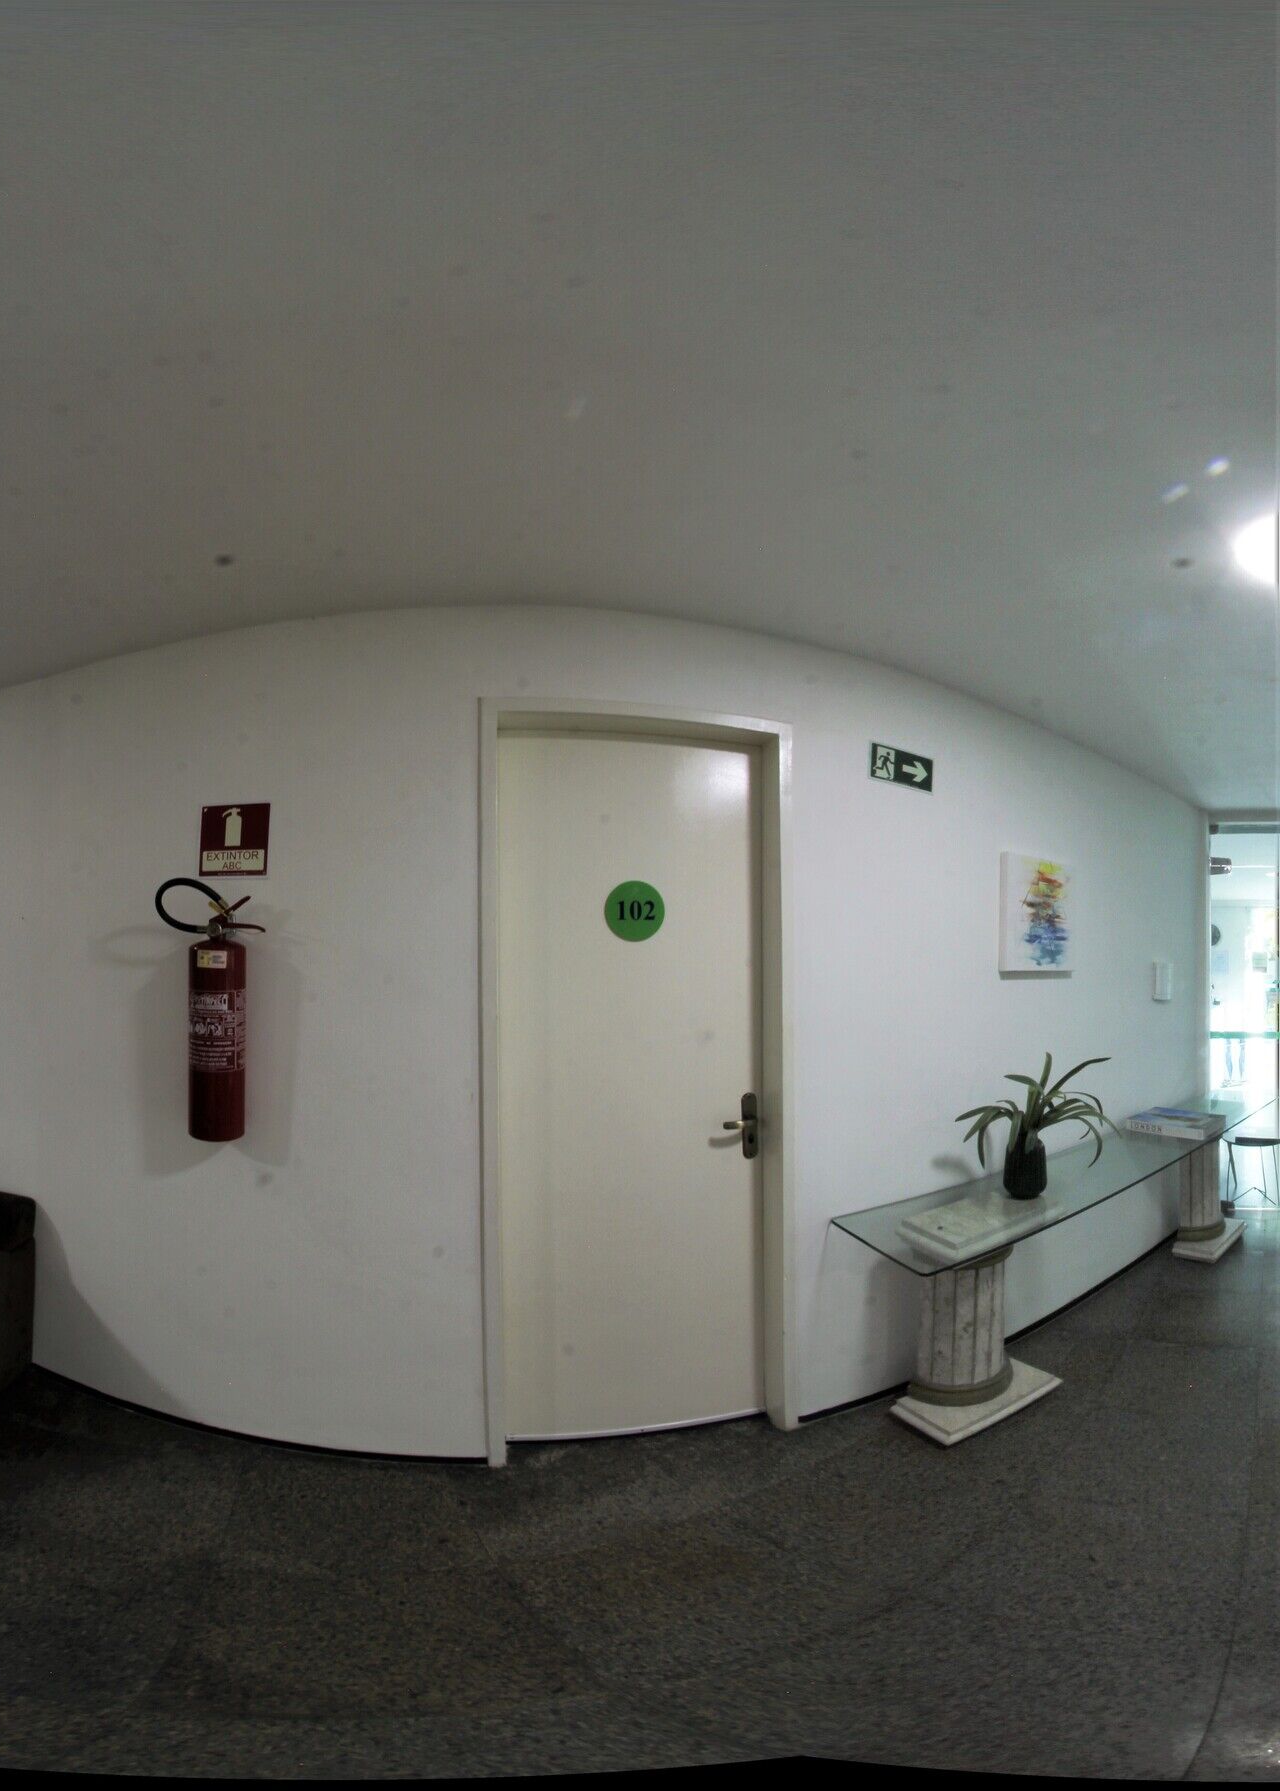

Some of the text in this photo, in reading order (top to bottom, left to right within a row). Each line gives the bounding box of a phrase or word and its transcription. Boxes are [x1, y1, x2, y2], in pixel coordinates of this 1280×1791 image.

[206, 850, 259, 861] EXTINTOR
[222, 861, 242, 870] ABC
[617, 900, 656, 921] 102
